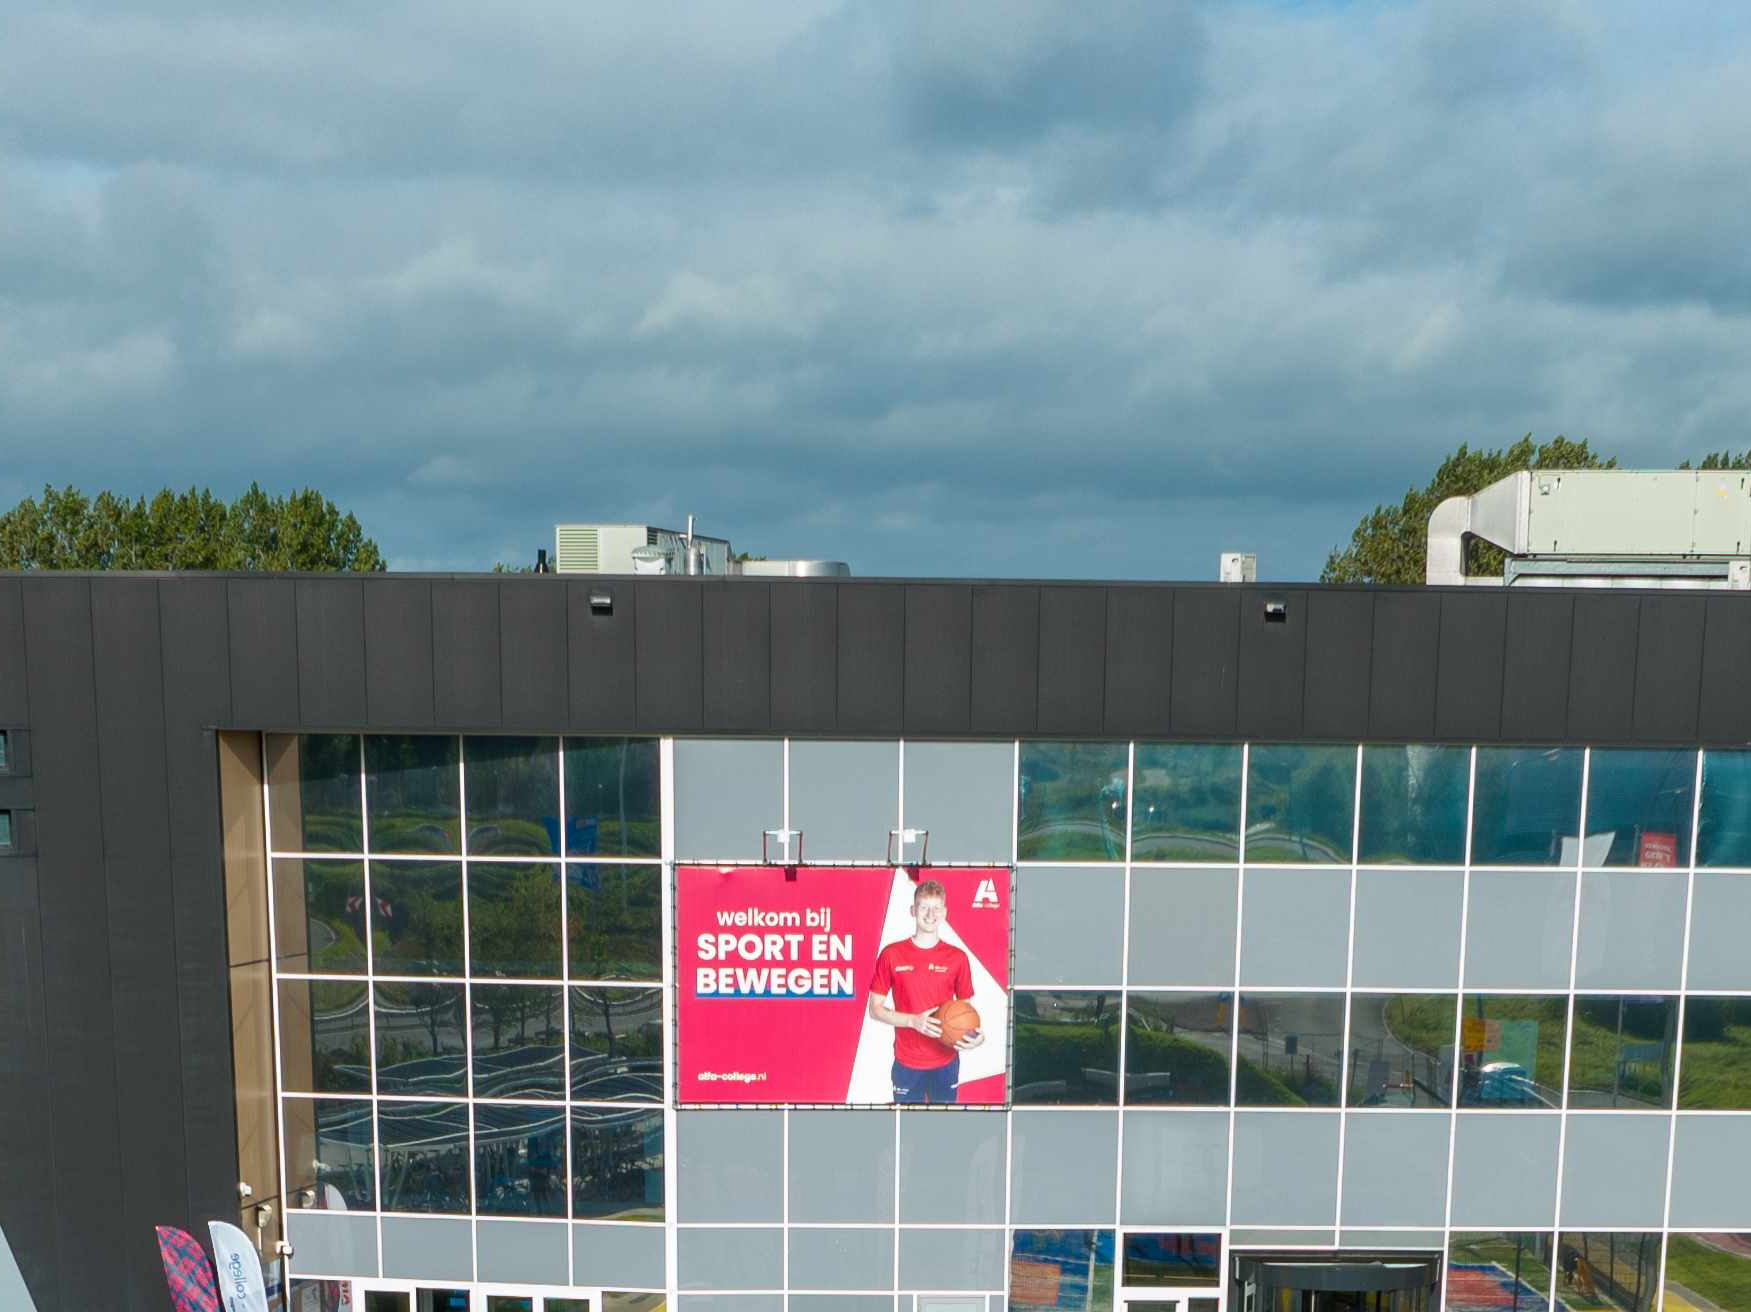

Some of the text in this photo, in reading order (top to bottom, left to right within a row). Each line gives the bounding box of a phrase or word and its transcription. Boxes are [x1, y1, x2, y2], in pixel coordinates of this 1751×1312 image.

[716, 907, 831, 933] welkom bij
[697, 934, 853, 961] SPORT EN
[696, 967, 854, 995] BEWEGEN
[697, 1071, 767, 1083] alfa-college.nl
